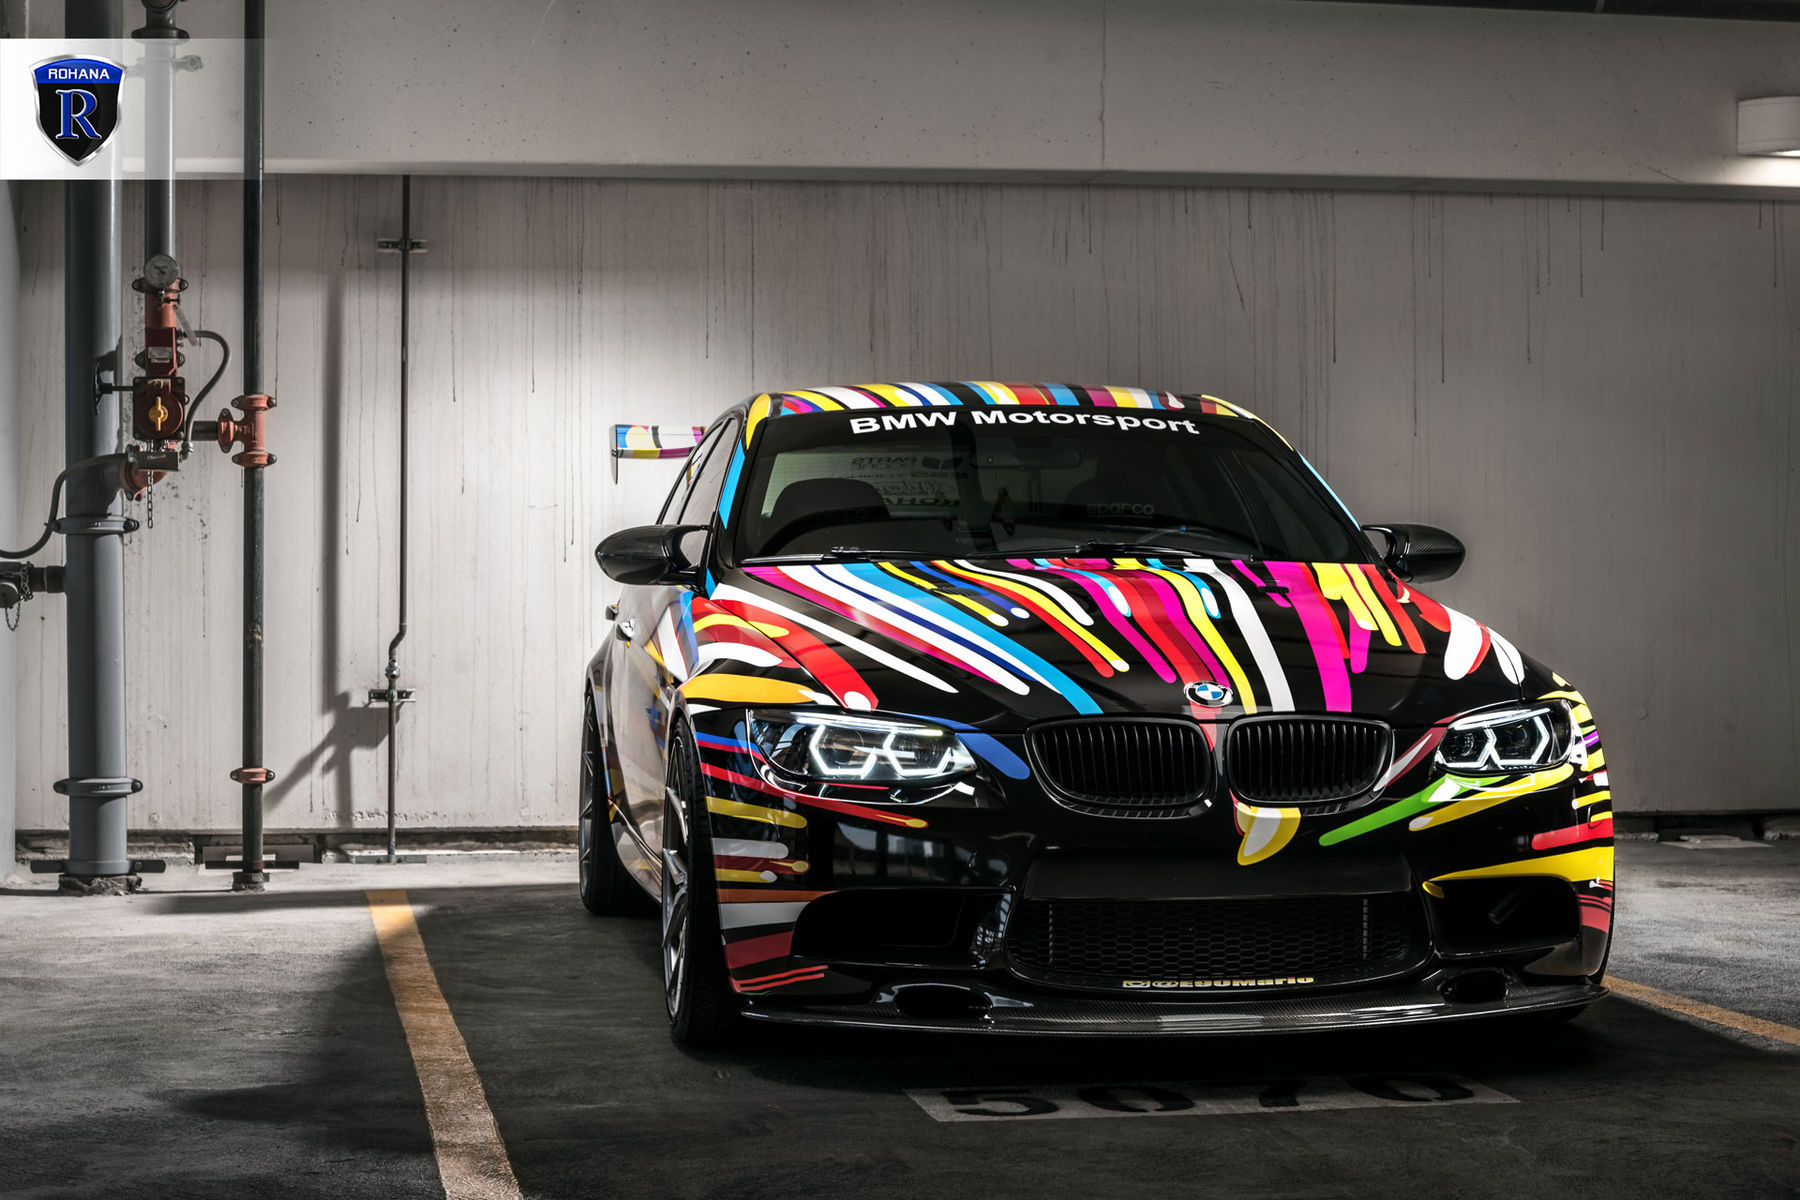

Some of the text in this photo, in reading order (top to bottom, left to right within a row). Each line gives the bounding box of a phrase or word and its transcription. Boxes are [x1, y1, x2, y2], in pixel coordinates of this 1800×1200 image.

[849, 410, 1201, 435] BMW Motorsport
[1086, 503, 1155, 519] sparco
